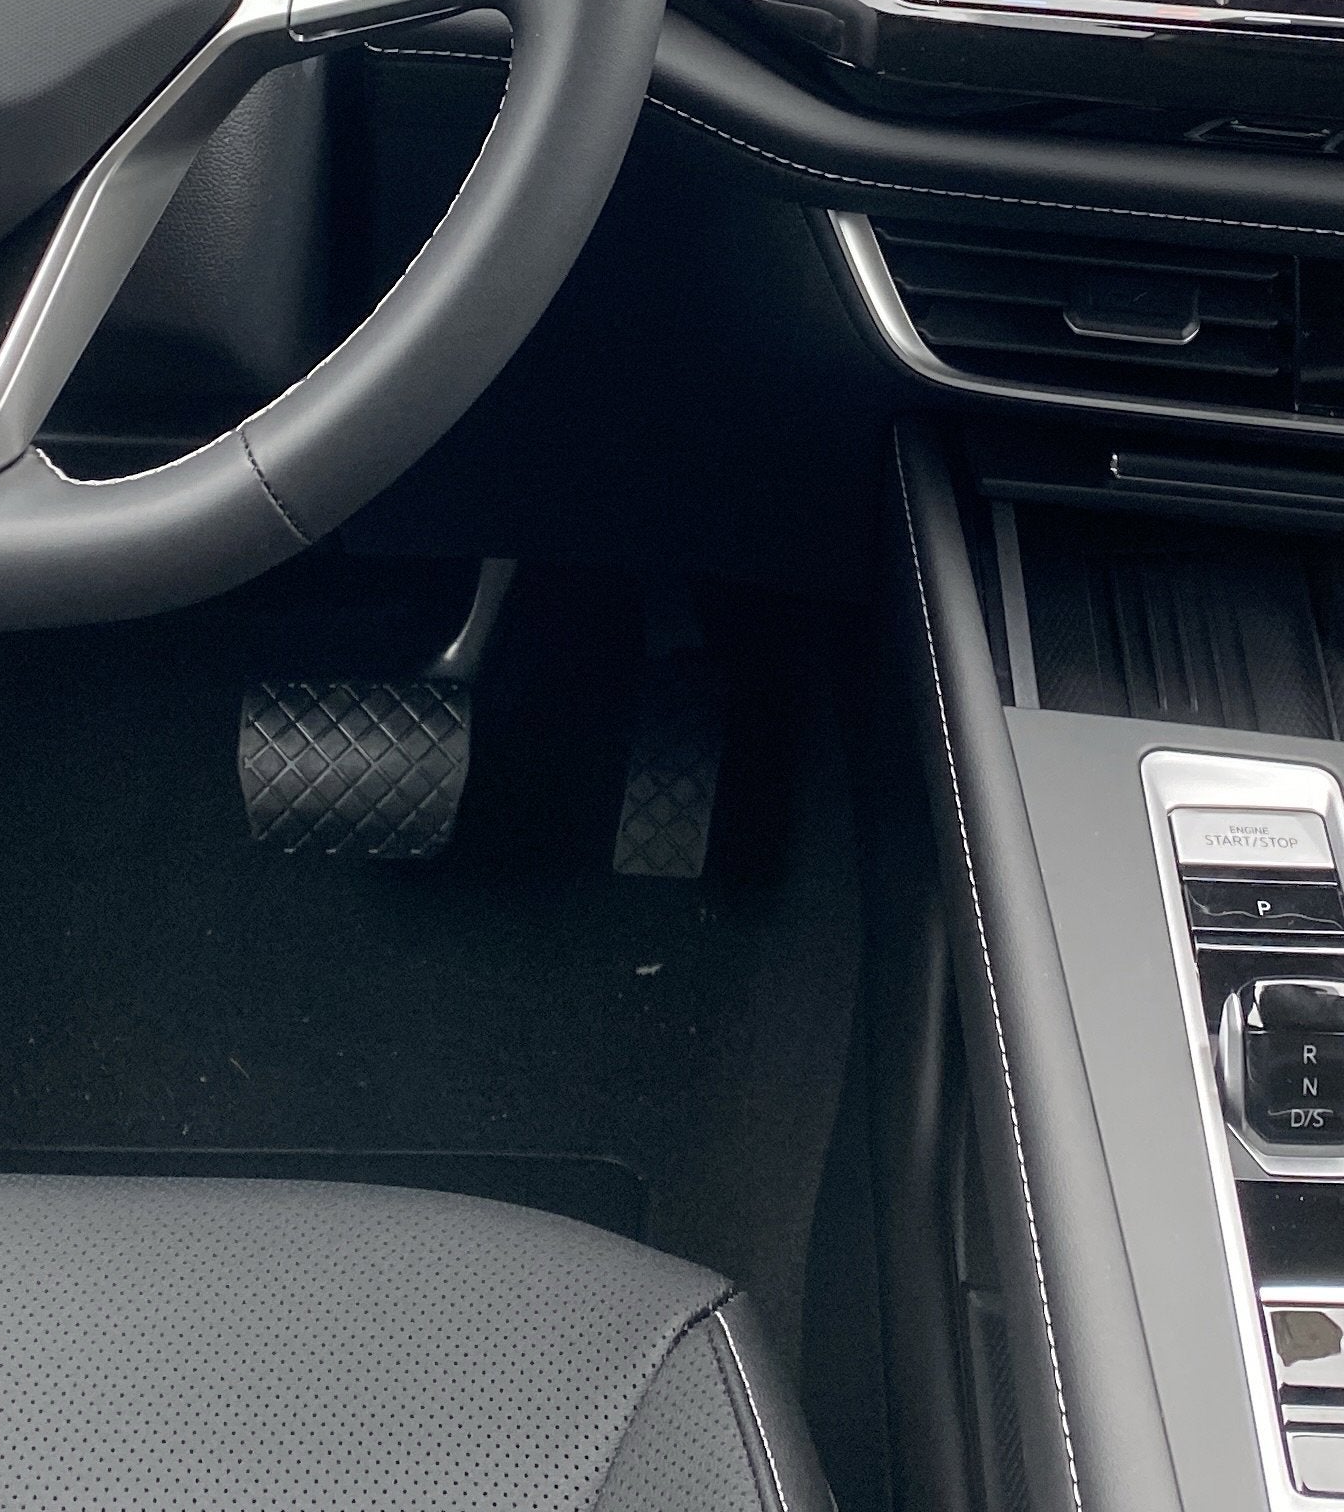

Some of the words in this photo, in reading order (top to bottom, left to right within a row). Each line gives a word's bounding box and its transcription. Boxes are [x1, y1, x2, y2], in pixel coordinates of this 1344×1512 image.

[1228, 824, 1269, 835] ENGINE
[1204, 835, 1298, 849] START/STOP
[1256, 900, 1272, 916] P
[1302, 1045, 1317, 1065] R
[1302, 1078, 1318, 1095] N
[1289, 1108, 1325, 1128] D/S
